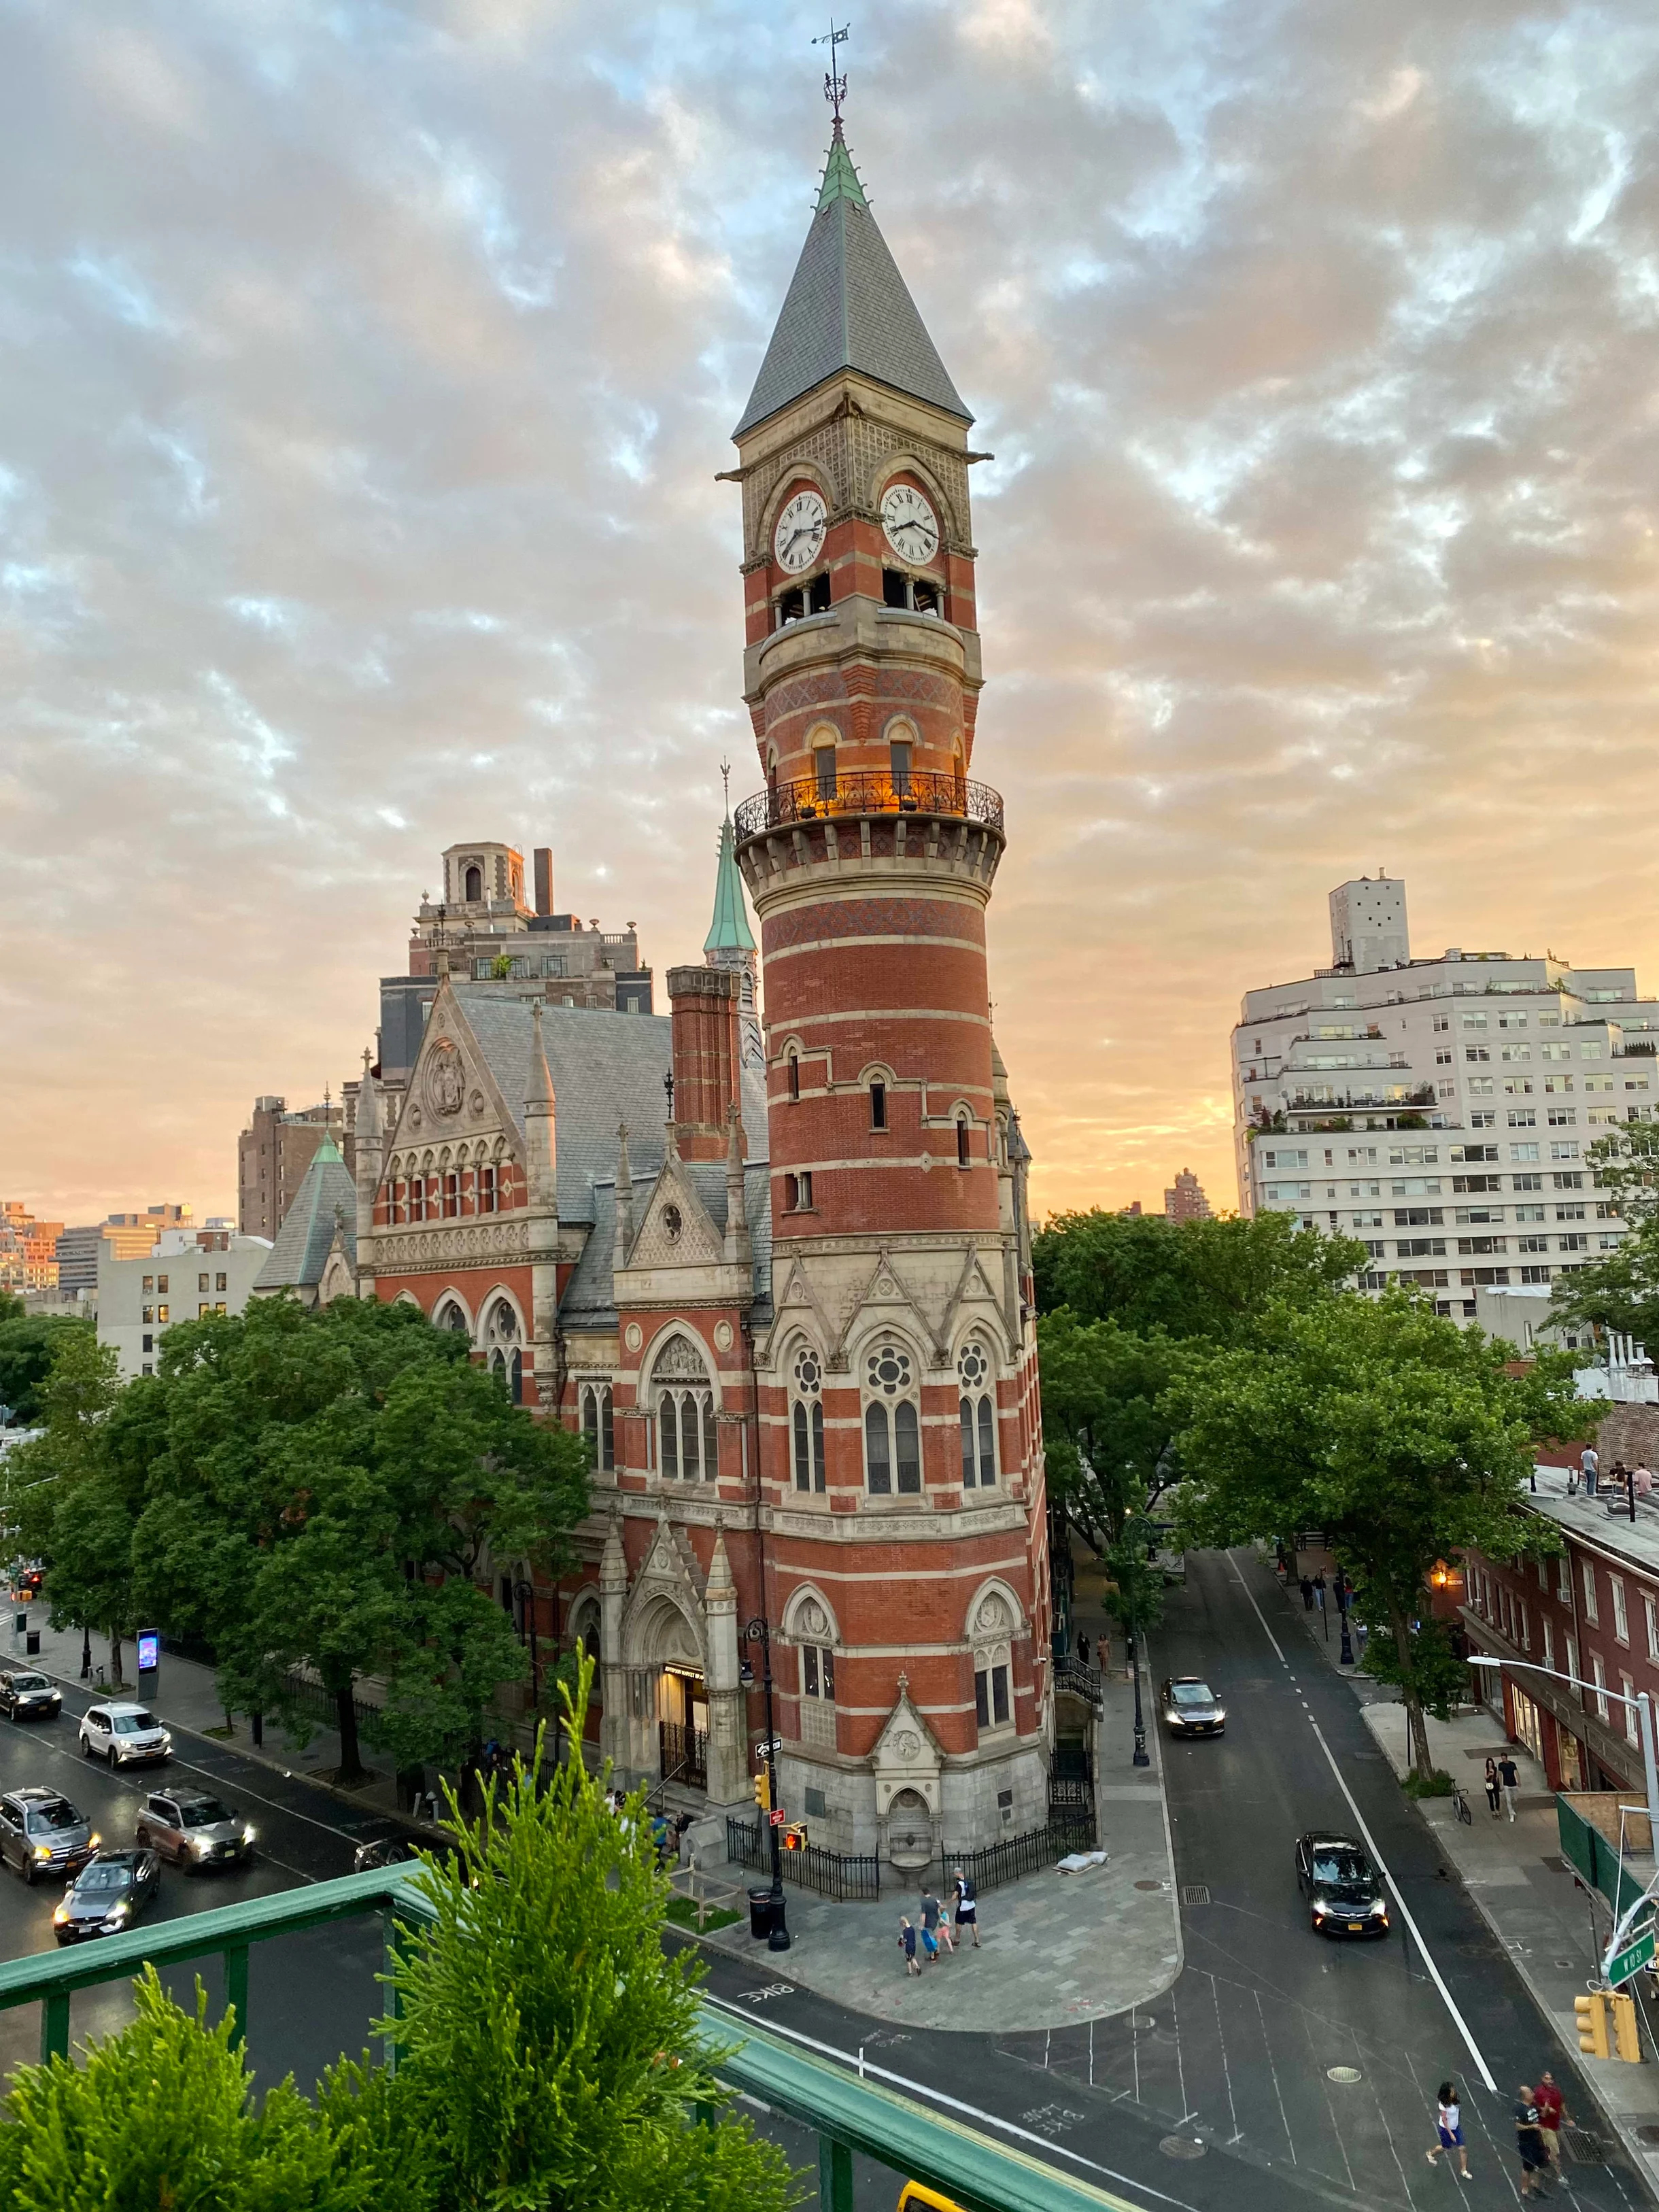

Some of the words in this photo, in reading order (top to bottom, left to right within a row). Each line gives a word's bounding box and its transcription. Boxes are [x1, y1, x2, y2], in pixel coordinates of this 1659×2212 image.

[1629, 1954, 1635, 1969] 10
[1637, 1949, 1642, 1963] St
[737, 1983, 795, 2003] BIKE
